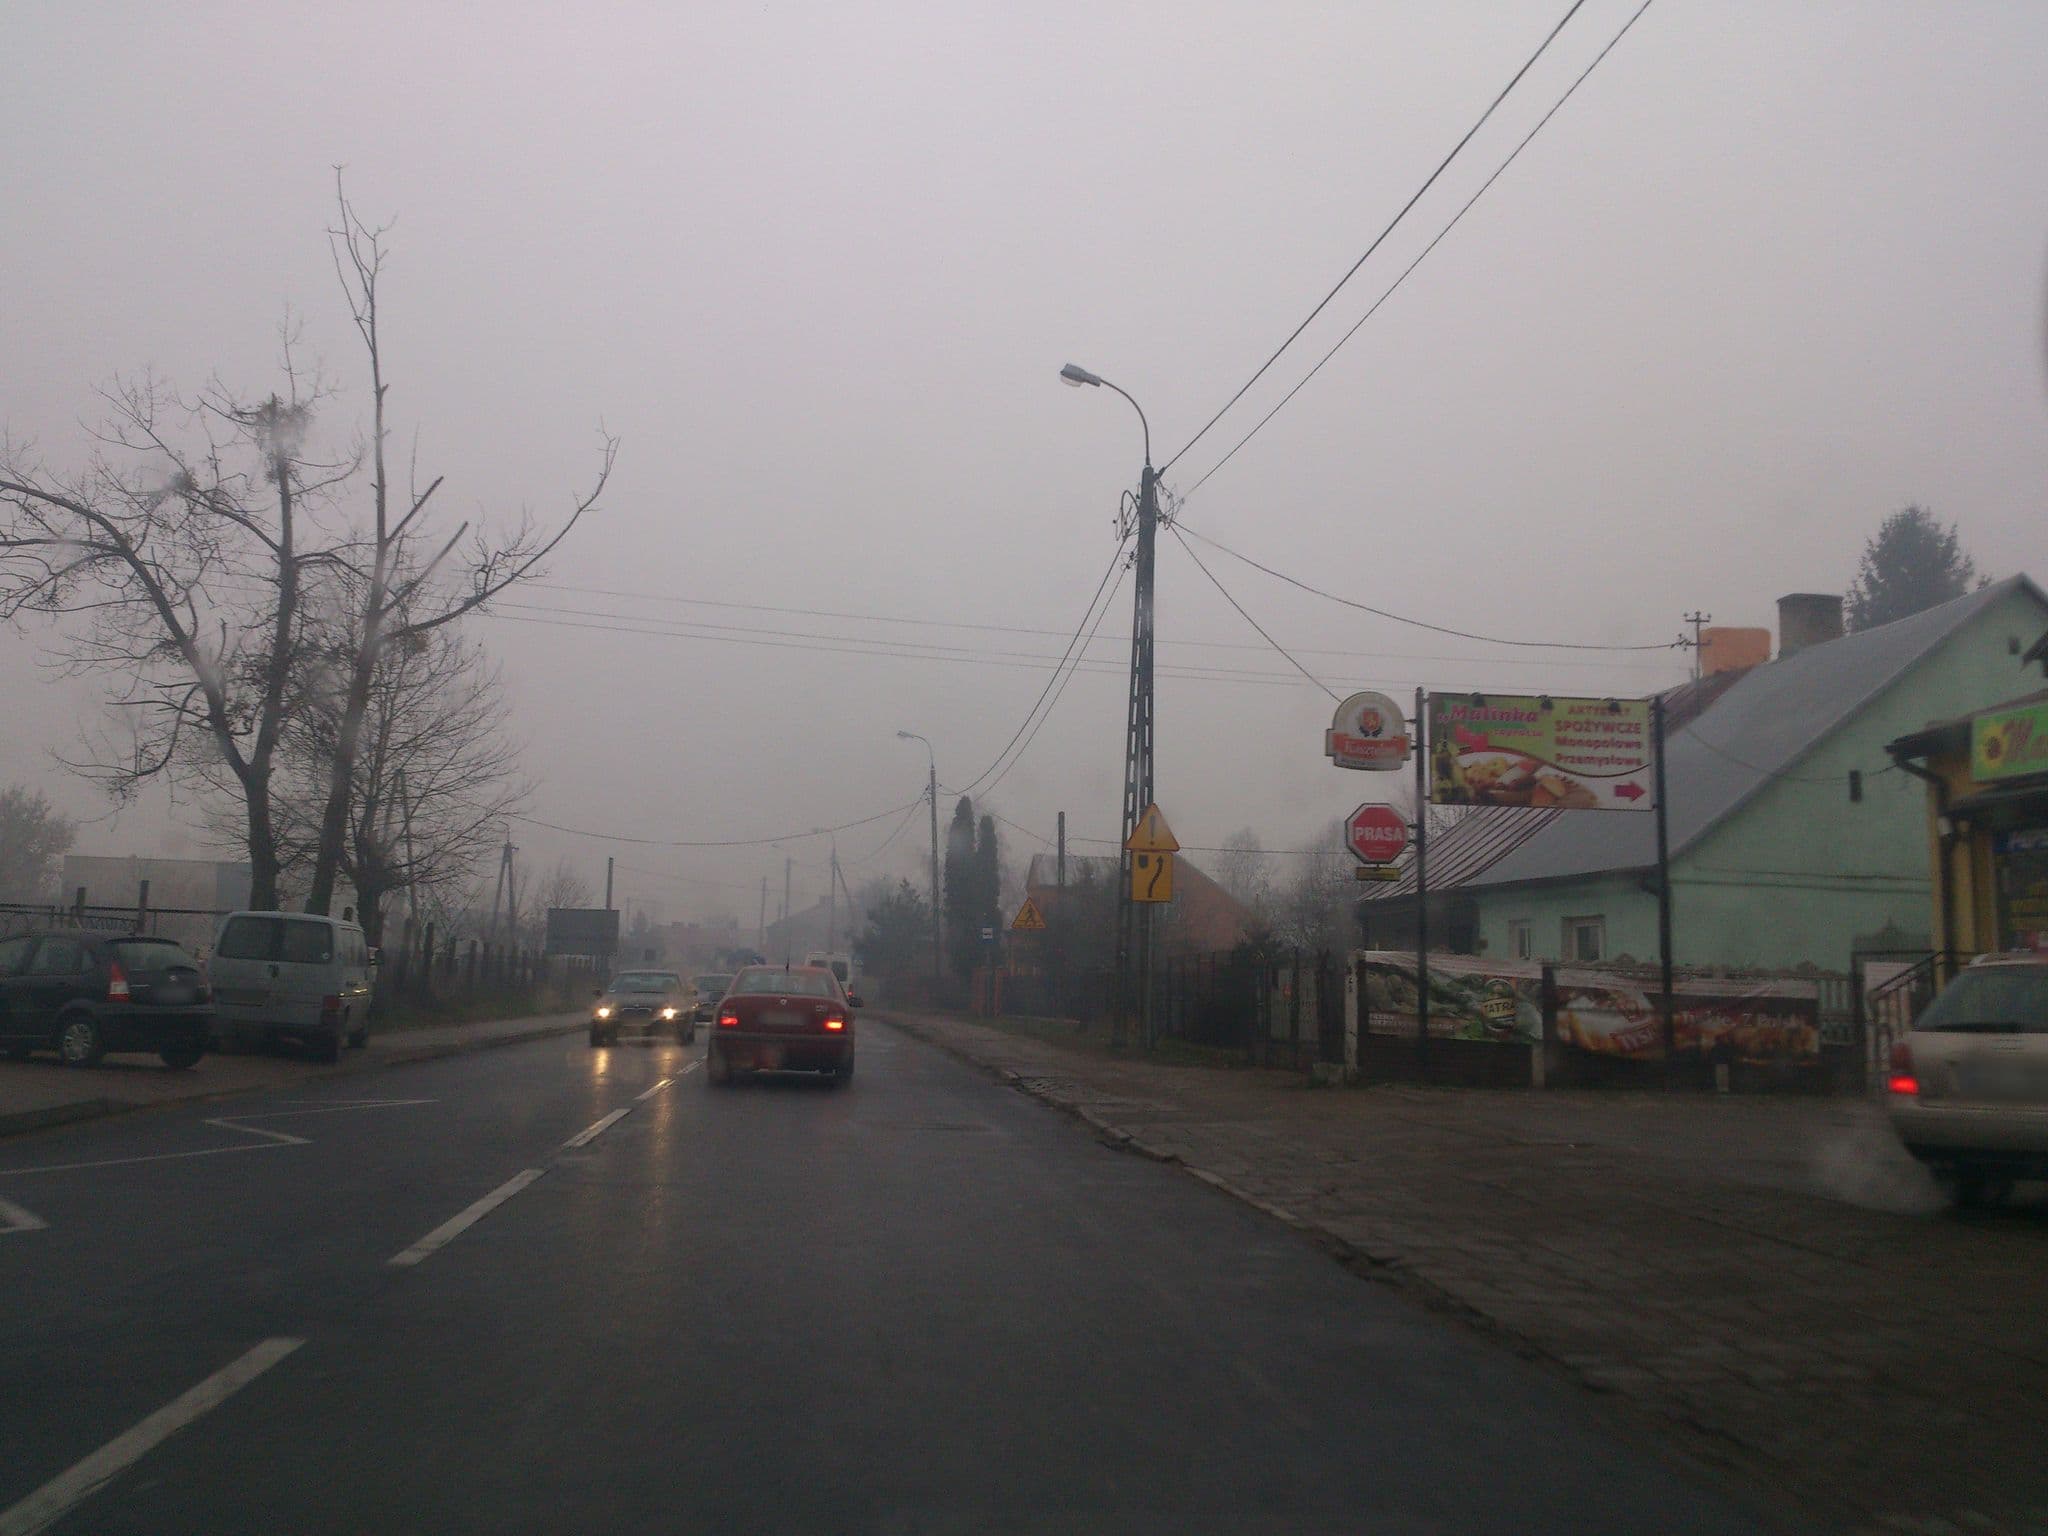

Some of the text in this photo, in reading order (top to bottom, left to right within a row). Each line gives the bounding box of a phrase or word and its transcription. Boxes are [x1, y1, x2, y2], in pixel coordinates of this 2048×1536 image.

[1555, 718, 1641, 734] SPOŻYWCZE
[1555, 735, 1641, 750] Monopolowe
[1354, 826, 1403, 841] PRASA
[1483, 1000, 1517, 1014] TATRA
